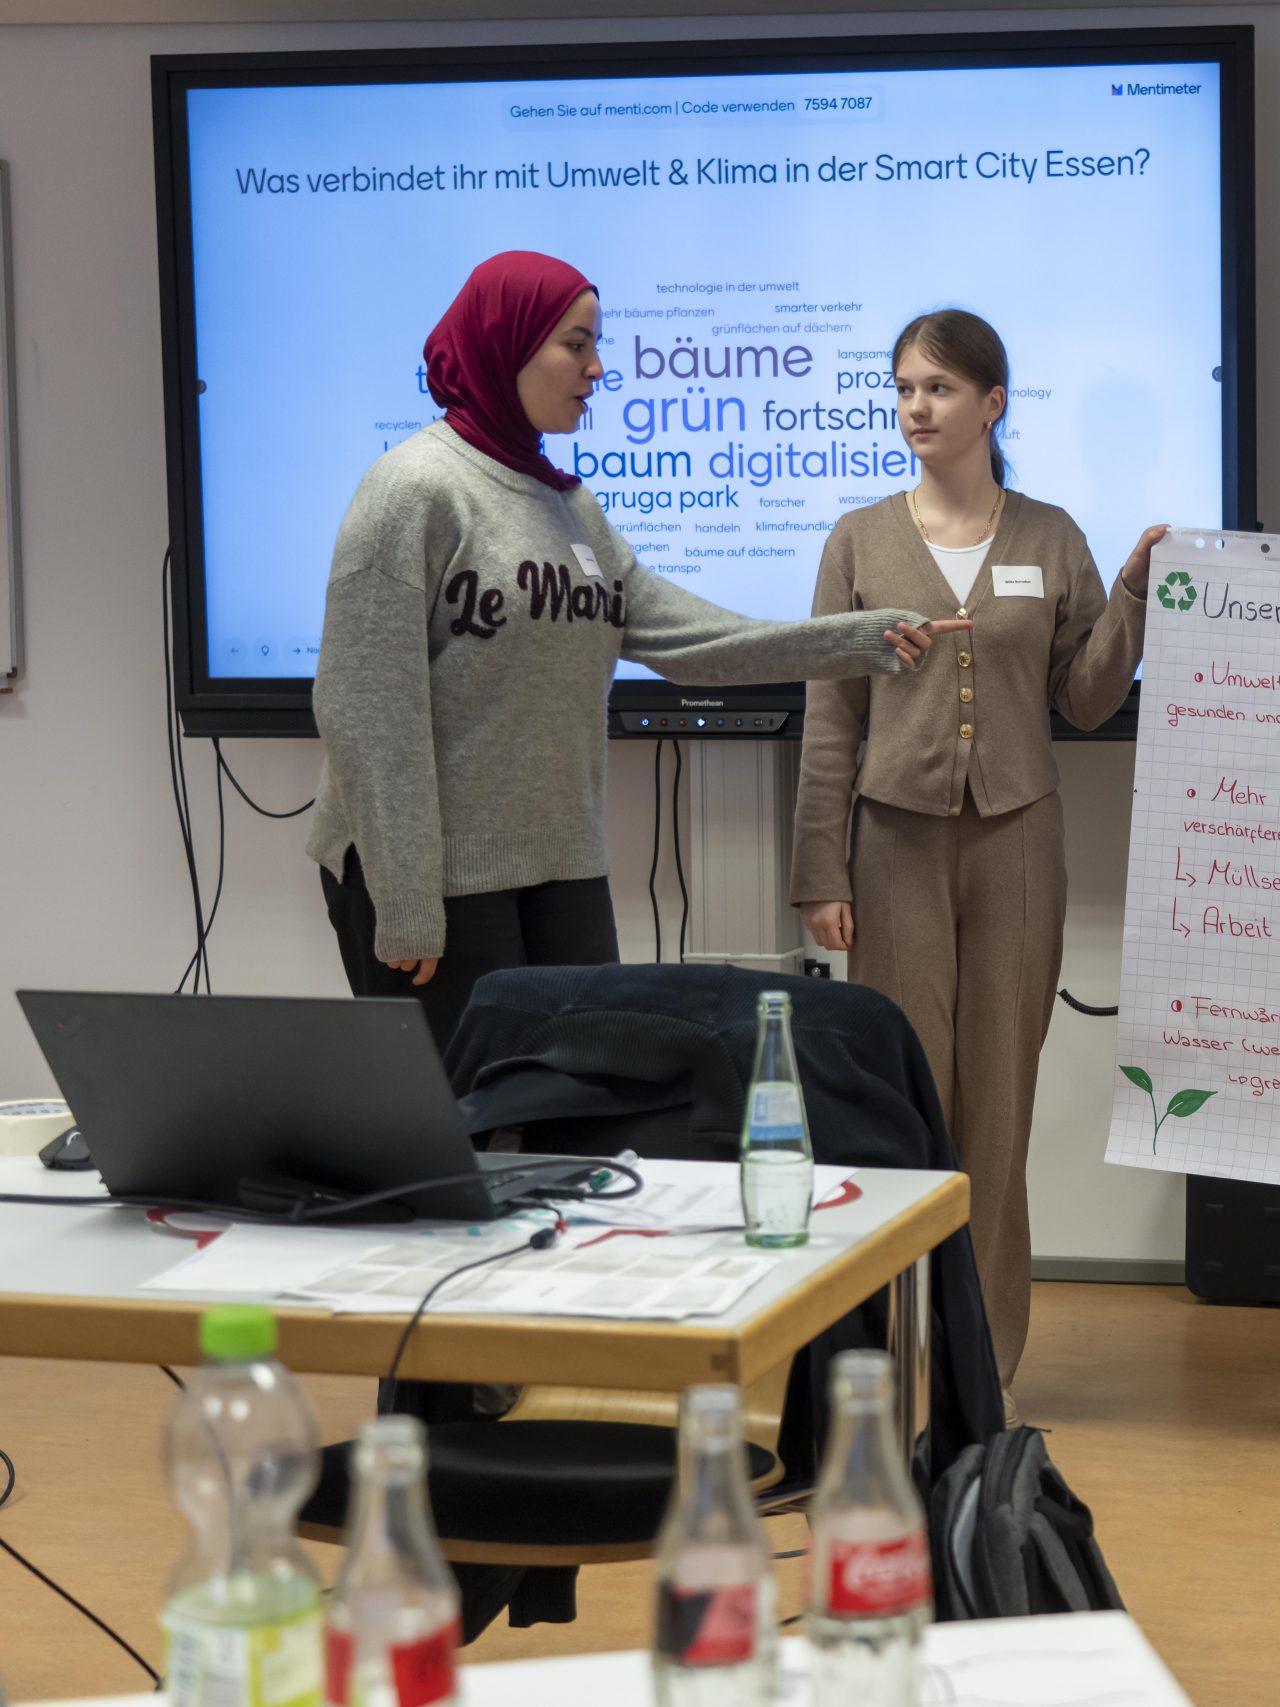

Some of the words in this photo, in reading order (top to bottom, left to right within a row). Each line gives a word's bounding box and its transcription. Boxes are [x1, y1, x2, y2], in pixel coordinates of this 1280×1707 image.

[1127, 82, 1202, 96] Mentimeter
[510, 105, 554, 118] Gehen
[557, 104, 578, 117] Sie
[580, 103, 602, 117] auf
[604, 103, 673, 116] menti.com
[681, 100, 717, 114] Code
[721, 100, 795, 113] verwenden
[804, 97, 838, 111] 7594
[840, 96, 873, 110] 7087
[235, 167, 300, 195] Was
[306, 164, 446, 193] verbindet
[453, 163, 488, 190] ihr
[495, 162, 540, 189] mit
[547, 159, 661, 188] Umwelt
[668, 158, 689, 186] &
[697, 157, 777, 185] Klima
[785, 157, 810, 183] in
[817, 155, 869, 183] der
[875, 153, 968, 182] Smart
[975, 151, 1038, 185] City
[1046, 147, 1151, 178] Essen?
[656, 282, 723, 295] technologie
[724, 282, 736, 293] in
[737, 281, 757, 292] der
[759, 280, 800, 292] umwelt
[624, 307, 665, 319] bäume
[666, 306, 715, 321] pflanzen
[774, 303, 819, 313] smarter
[820, 301, 863, 313] verkehr
[711, 322, 780, 337] grünflächen
[782, 322, 802, 334] auf
[804, 322, 852, 334] dächern
[634, 334, 813, 380] bäume
[622, 386, 746, 446] grün
[374, 419, 422, 433] recyclen
[573, 442, 691, 478] baum
[596, 490, 673, 514] gruga
[679, 484, 739, 514] park
[759, 496, 806, 508] forscher
[695, 522, 741, 534] handeln
[684, 546, 725, 558] bäume
[726, 546, 746, 558] auf
[747, 546, 796, 558] dächern
[657, 563, 702, 575] transpo
[445, 570, 507, 639] Le
[680, 698, 724, 708] Promethean
[1166, 700, 1246, 727] gesunden
[1210, 776, 1266, 807] Mehr
[1202, 905, 1273, 940] Arbeit
[1162, 1030, 1235, 1052] Wasser
